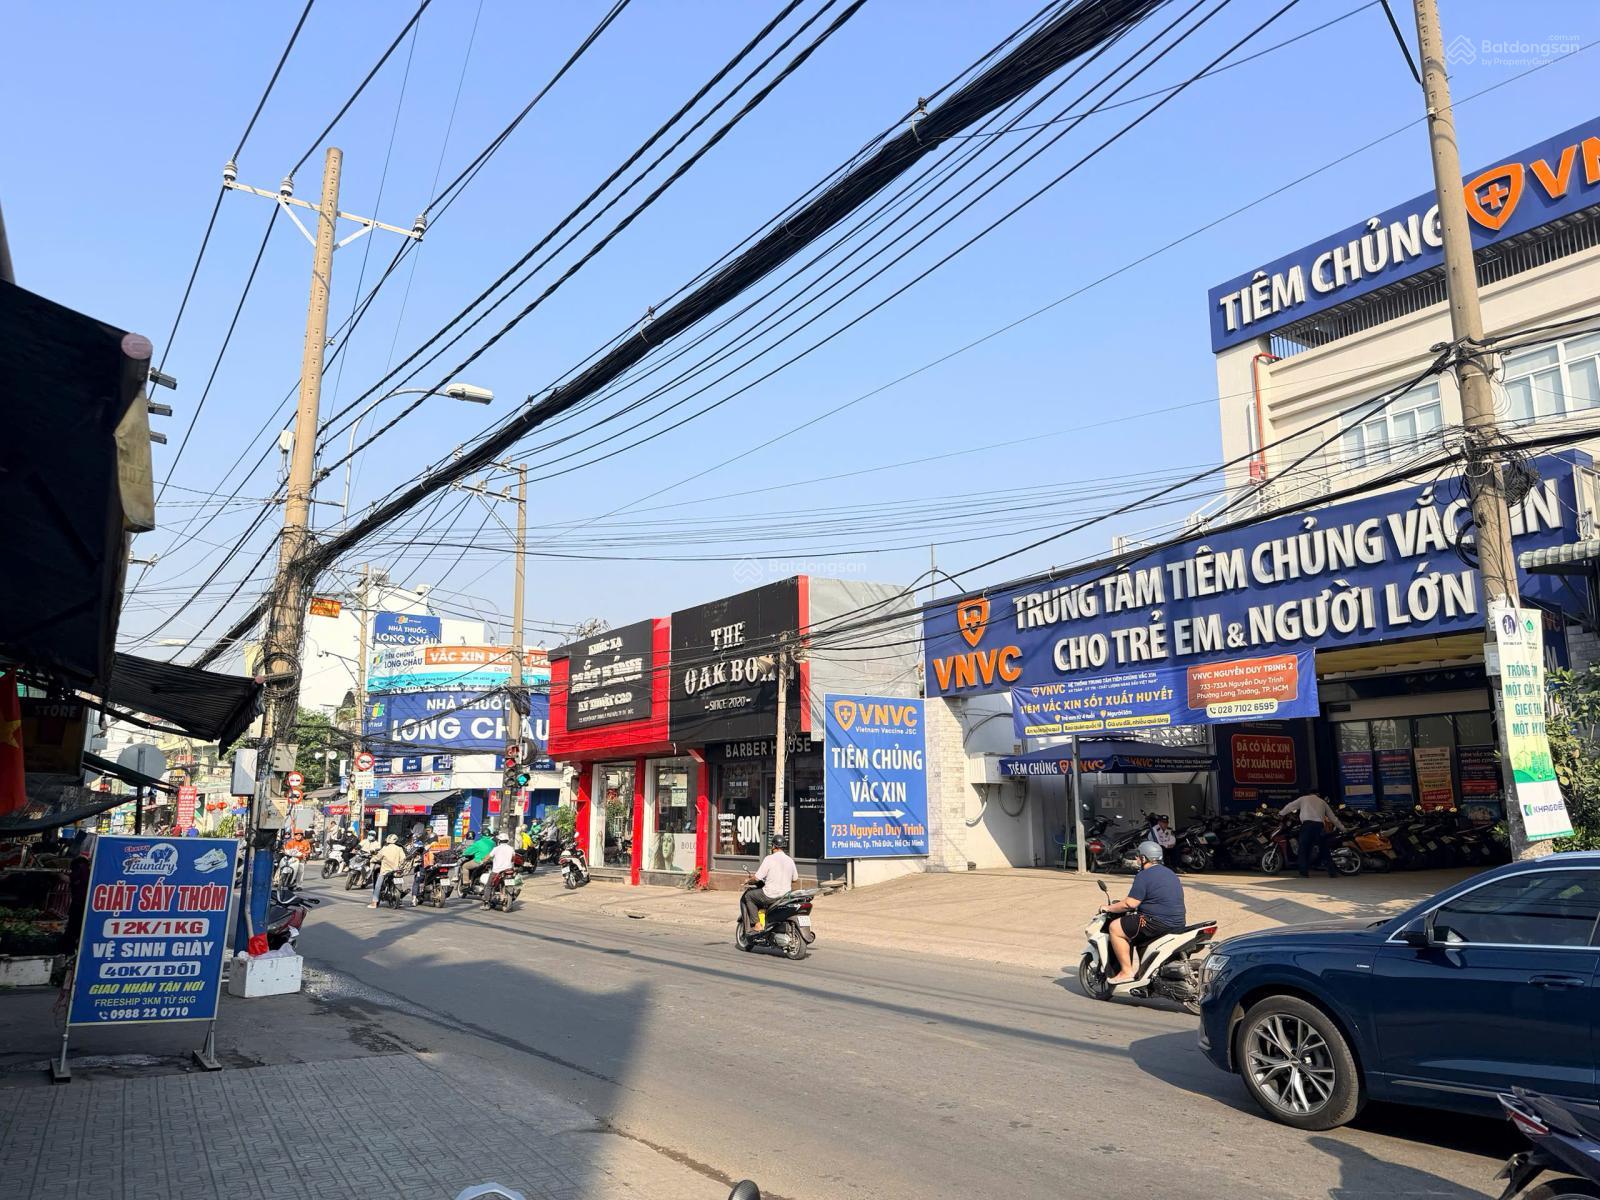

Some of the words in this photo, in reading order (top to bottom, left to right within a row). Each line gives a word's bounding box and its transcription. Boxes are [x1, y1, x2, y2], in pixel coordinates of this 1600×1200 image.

[1219, 271, 1306, 331] TIÊM
[1311, 204, 1444, 294] CHỦNG
[1012, 581, 1098, 629] TRUNG
[1100, 564, 1165, 613] TÂM
[1167, 545, 1249, 600] TIÊM
[1251, 516, 1387, 585] CHỦNG
[1387, 486, 1475, 558] VẮC
[1053, 633, 1109, 672] CHO
[1111, 609, 1169, 664] TRẺ
[1173, 613, 1224, 656] EM
[1227, 622, 1248, 648] &
[1249, 578, 1377, 645] NGƯỜI
[1386, 562, 1478, 626] LỚN
[711, 621, 745, 651] THE
[933, 645, 1024, 690] VNVC
[1192, 670, 1212, 680] VNVC
[1213, 666, 1245, 678] NGUYỄN
[1245, 666, 1262, 674] DUY
[1263, 663, 1286, 672] TRINH
[684, 661, 727, 695] OAK
[1040, 684, 1066, 697] VNVC
[1272, 684, 1289, 692] HCM
[427, 695, 455, 711] NHÀ
[1042, 699, 1061, 713] VẮC
[1064, 700, 1082, 710] XIN
[1084, 694, 1103, 708] SỐT
[1105, 690, 1133, 706] XUẤT
[1136, 685, 1174, 702] HUYẾT
[858, 703, 917, 727] VNVC
[1217, 704, 1233, 714] 028
[1235, 703, 1252, 712] 7102
[1254, 702, 1275, 711] 6595
[392, 717, 461, 741] LONG
[726, 741, 767, 758] BARBER
[831, 744, 869, 768] TIÊM
[872, 743, 922, 770] CHỦNG
[1277, 743, 1290, 753] XIN
[1007, 761, 1027, 775] TIÊM
[1028, 759, 1058, 775] CHỦNG
[850, 775, 880, 803] VẮC
[882, 781, 906, 803] XIN
[737, 815, 760, 843] 90K
[831, 824, 847, 836] 733
[849, 822, 883, 839] Nguyễn
[885, 823, 902, 839] Duy
[902, 823, 925, 836] Trinh
[123, 859, 175, 874] Laundry
[92, 881, 138, 916] GIẶT
[139, 878, 176, 912] SẤY
[178, 883, 229, 912] THƠM
[111, 921, 204, 935] 12K/1KG
[92, 940, 116, 960] VỆ
[121, 942, 167, 957] SINH
[172, 940, 214, 957] GIÀY
[104, 963, 196, 977] 40K/1ĐÔI
[89, 984, 119, 995] GIAO
[121, 981, 156, 995] NHẬN
[158, 981, 181, 994] TẬN
[183, 980, 206, 992] NƠI
[94, 997, 141, 1007] FREESHIP
[142, 996, 161, 1006] 3KM
[163, 995, 177, 1004] TỪ
[178, 995, 197, 1004] 5KG
[110, 1008, 139, 1019] 0988
[142, 1008, 157, 1018] 22
[161, 1007, 189, 1017] 0710
